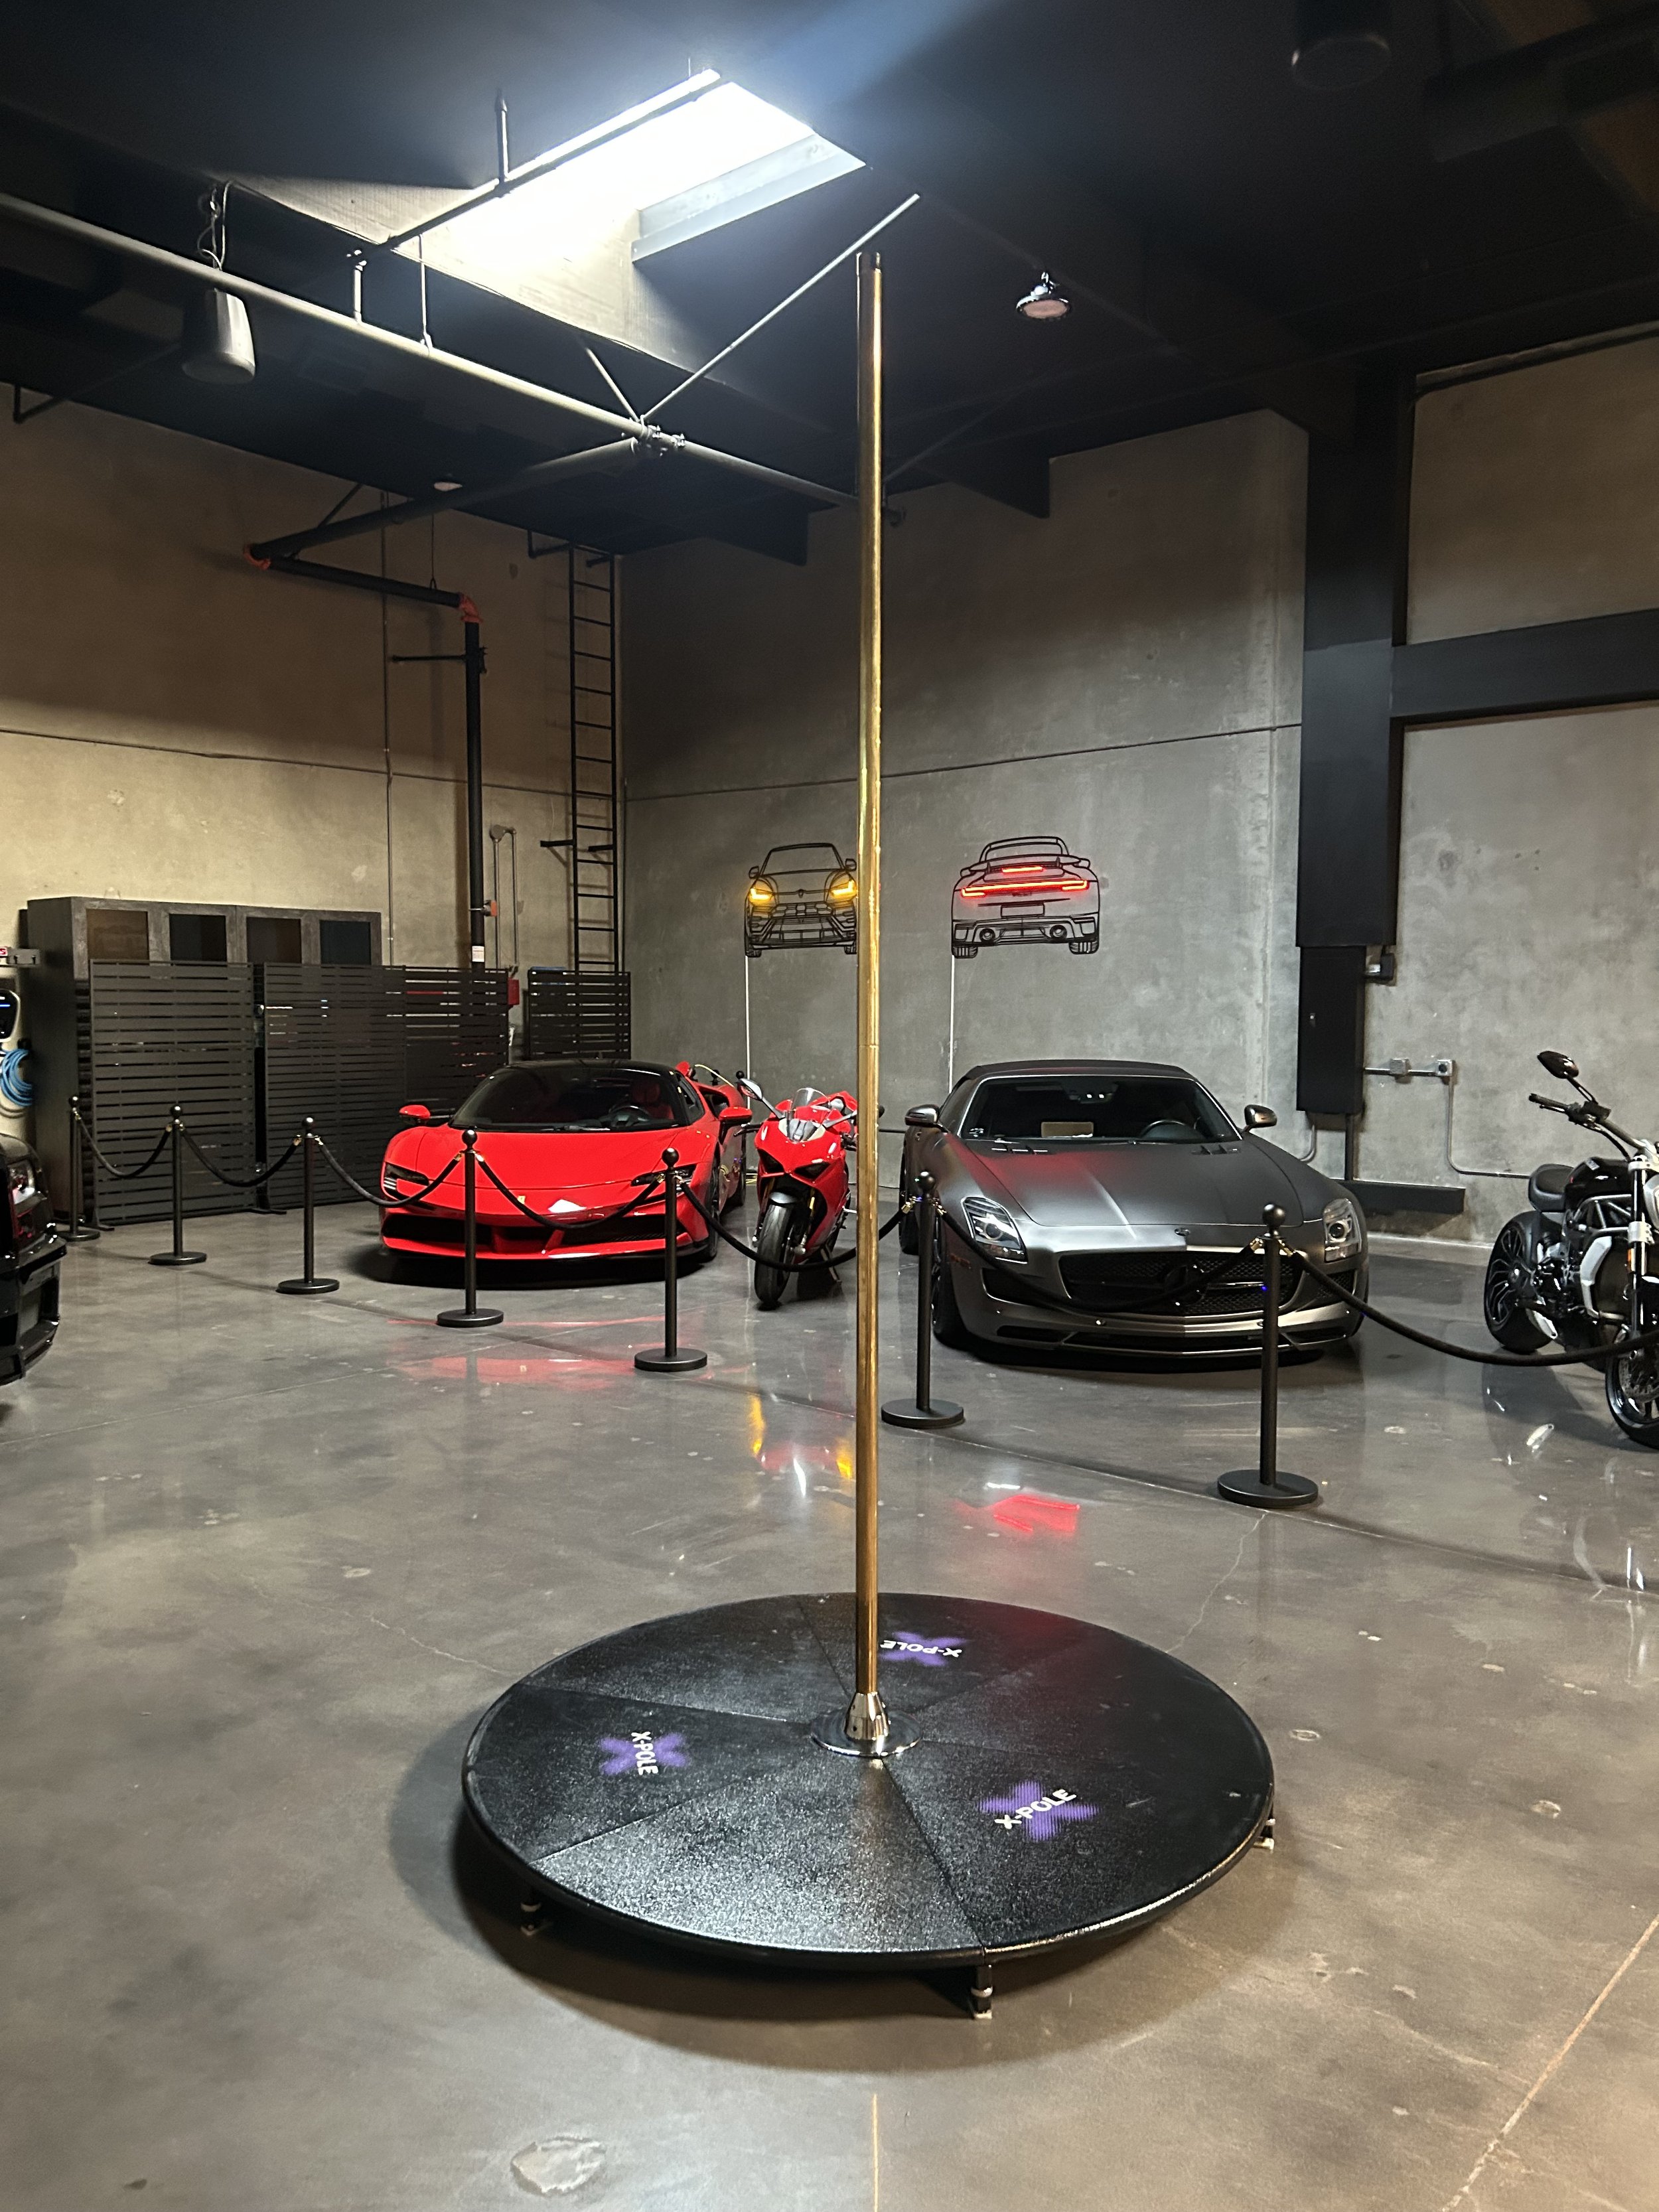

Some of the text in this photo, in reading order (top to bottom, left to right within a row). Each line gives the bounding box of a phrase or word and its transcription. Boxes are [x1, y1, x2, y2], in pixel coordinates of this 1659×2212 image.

[880, 1640, 962, 1658] X-POLE
[631, 1731, 659, 1775] X-POLE
[994, 1789, 1077, 1830] X-POLE
